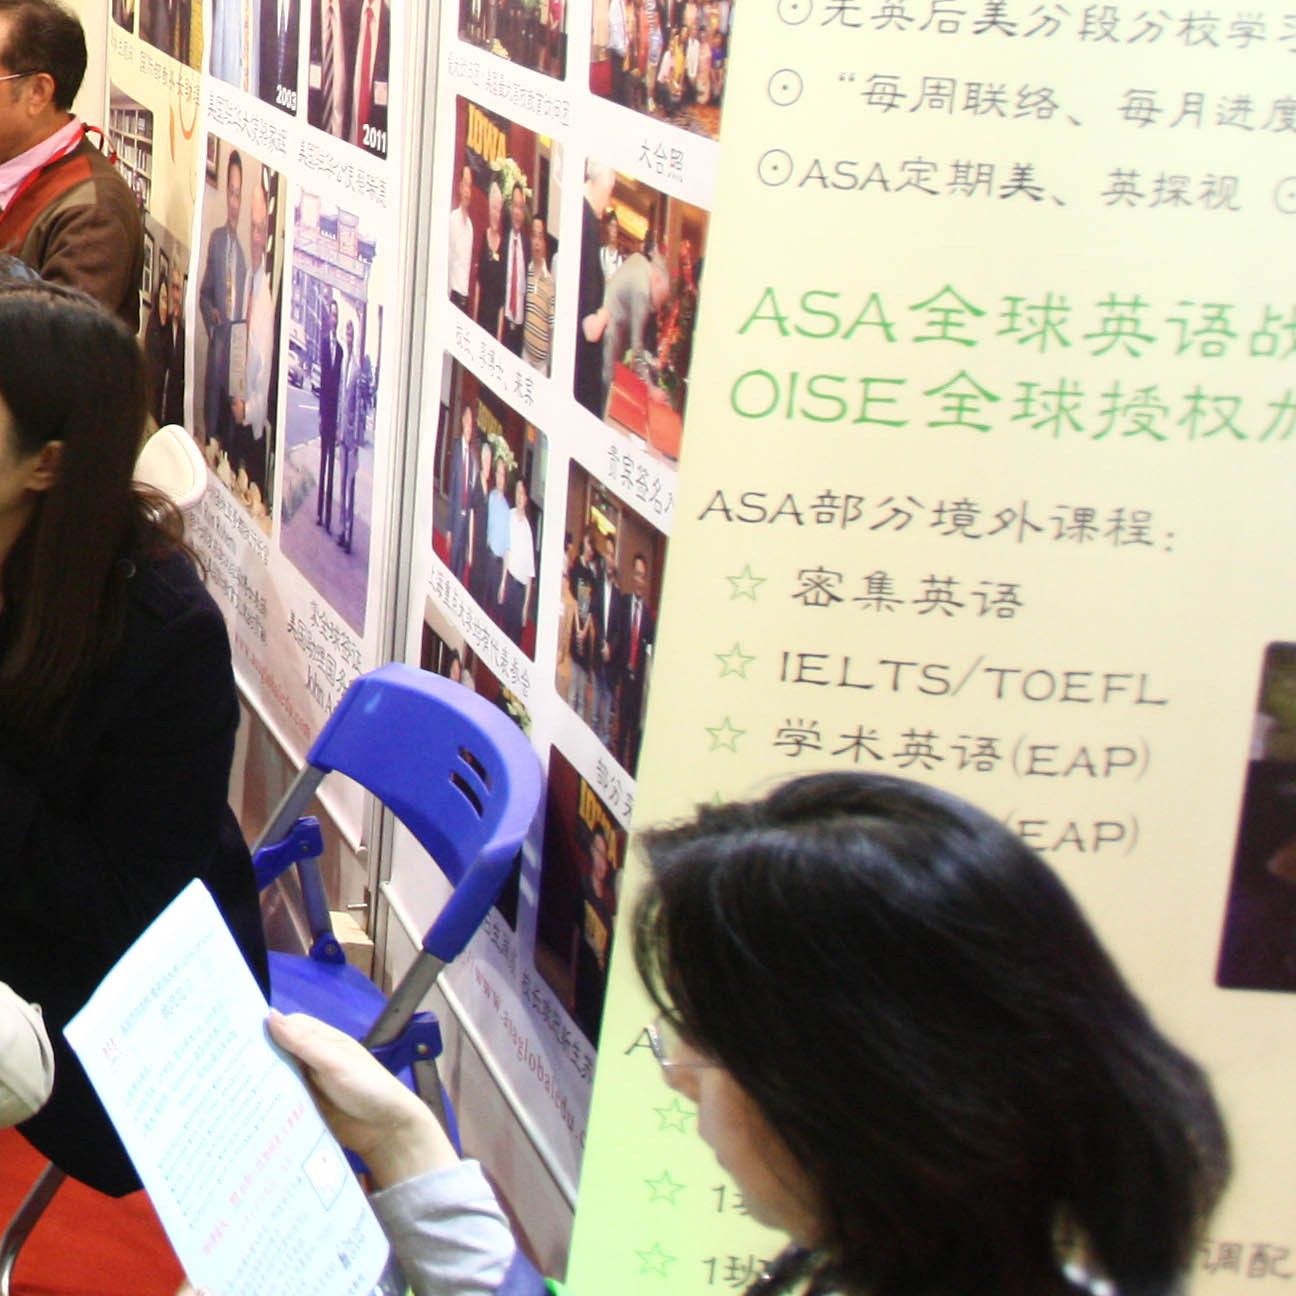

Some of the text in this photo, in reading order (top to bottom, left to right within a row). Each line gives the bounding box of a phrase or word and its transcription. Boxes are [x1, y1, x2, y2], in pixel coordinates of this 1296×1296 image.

[362, 123, 387, 153] 2011
[790, 565, 1026, 621] 密集英语
[778, 649, 1171, 708] IELTS/TOEFL
